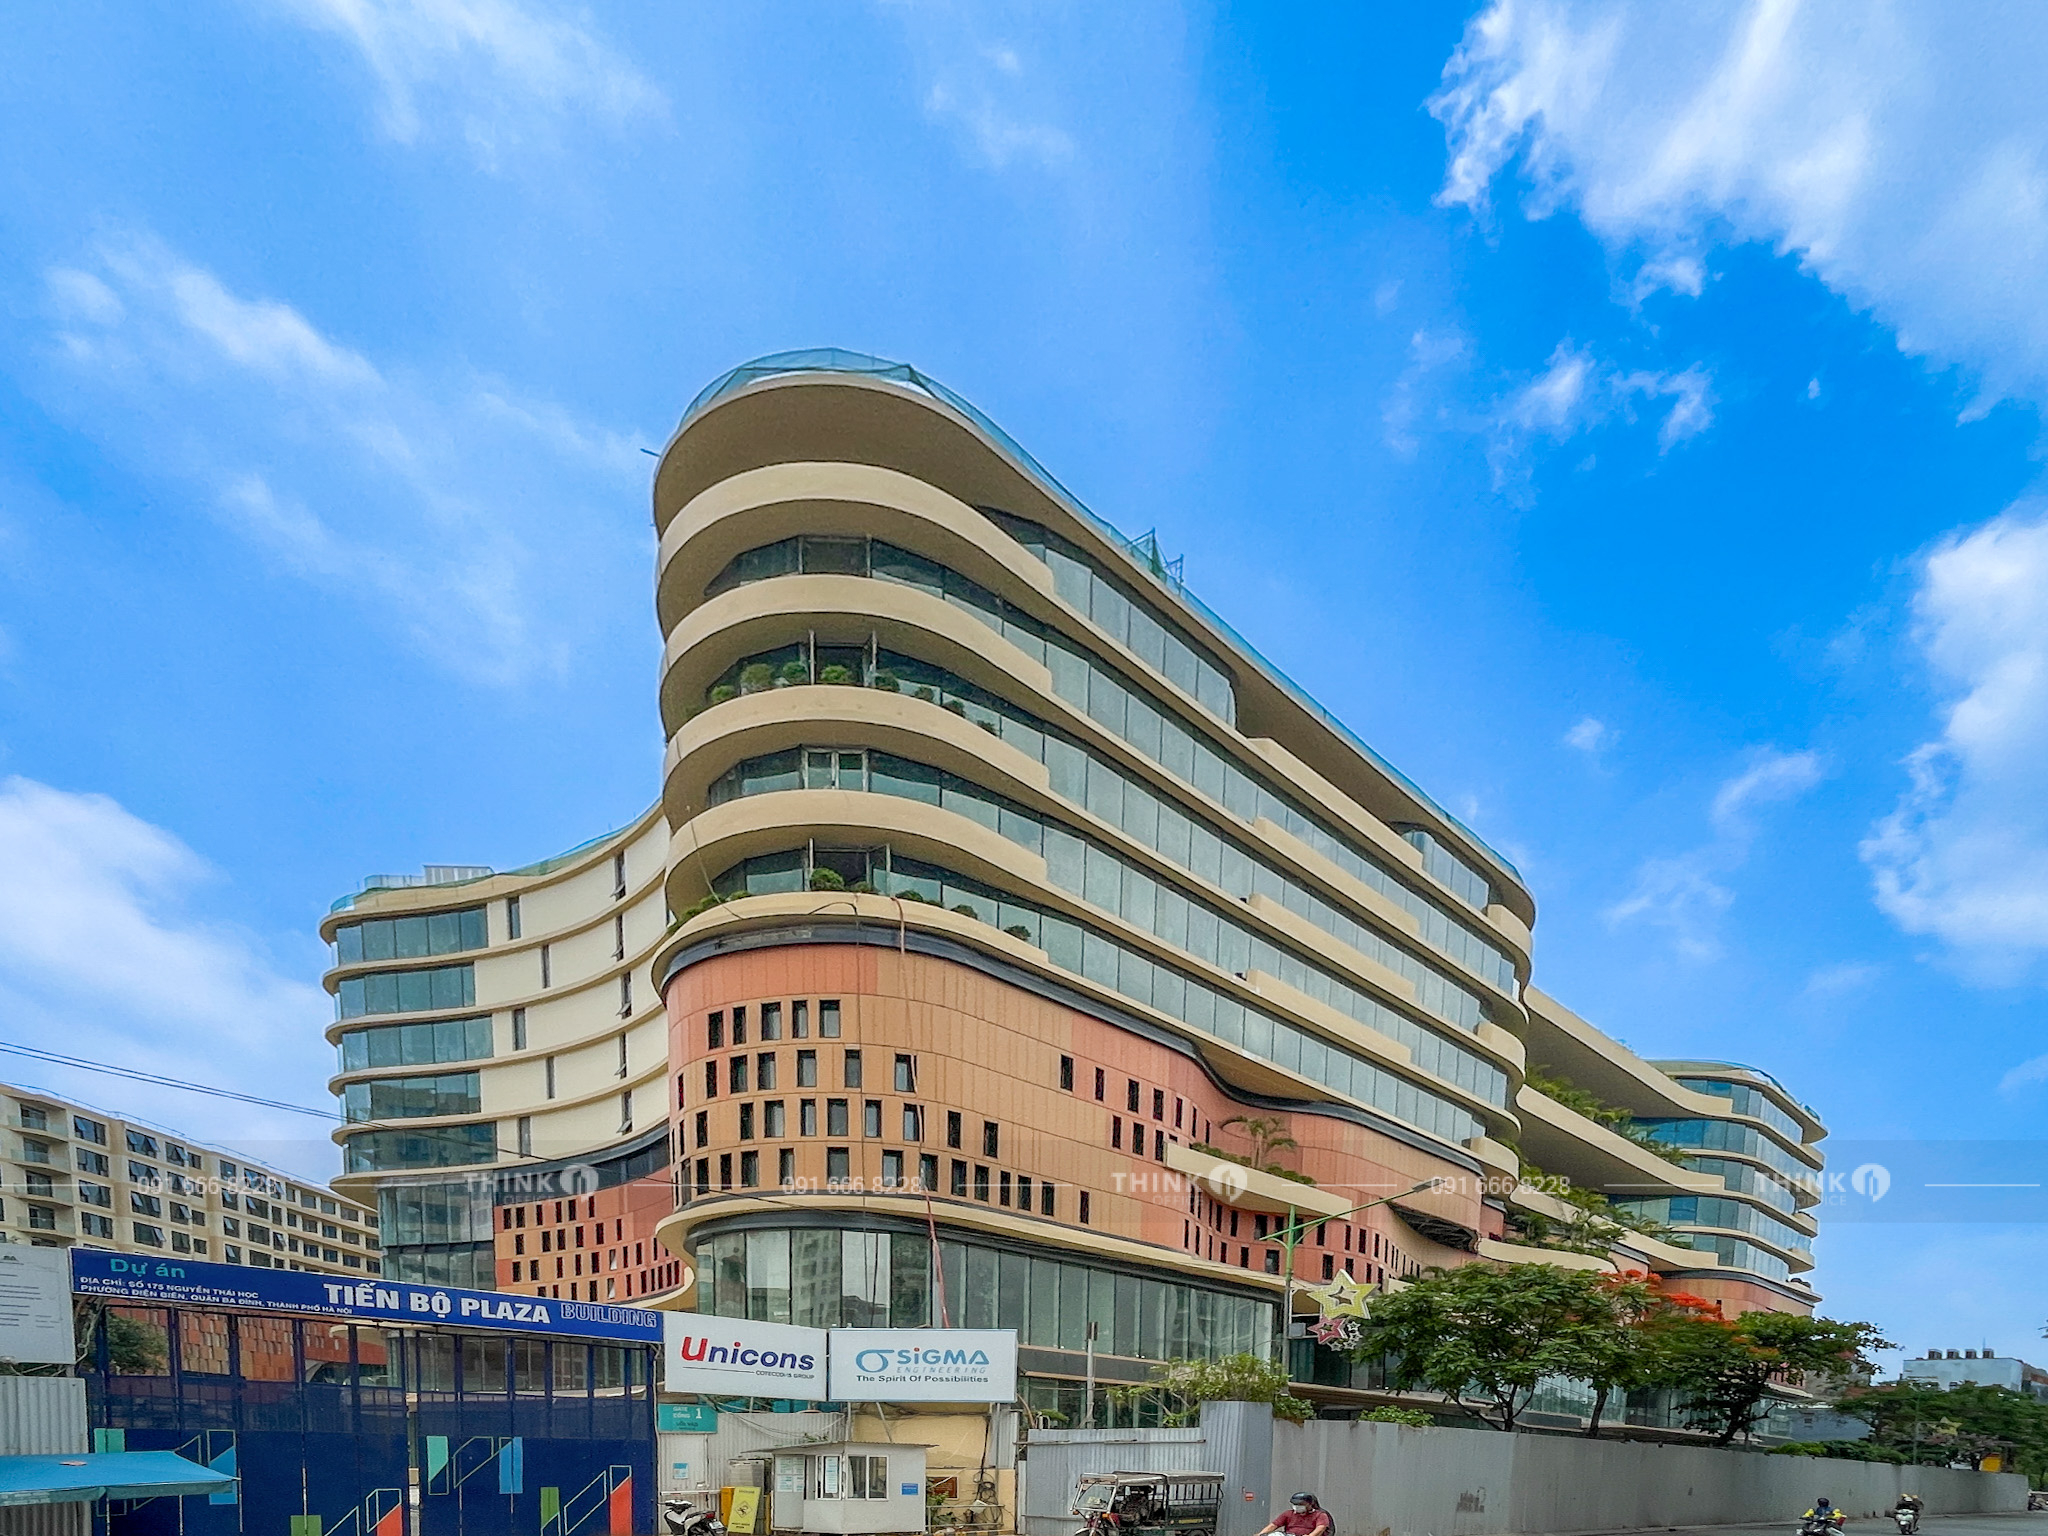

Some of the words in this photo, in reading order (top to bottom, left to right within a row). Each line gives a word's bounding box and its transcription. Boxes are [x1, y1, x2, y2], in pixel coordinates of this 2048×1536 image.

[110, 1258, 148, 1277] Dự
[154, 1262, 186, 1279] án
[147, 1282, 164, 1290] 175
[323, 1282, 399, 1310] TIẾN
[409, 1291, 451, 1318] BỘ
[460, 1297, 551, 1324] PLAZA
[560, 1302, 657, 1328] BUILDING
[681, 1336, 815, 1371] Unicons
[856, 1375, 876, 1383] The
[878, 1375, 907, 1385] Spirit
[909, 1374, 922, 1383] Of
[924, 1375, 989, 1384] Possibilities
[696, 1408, 702, 1419] 1
